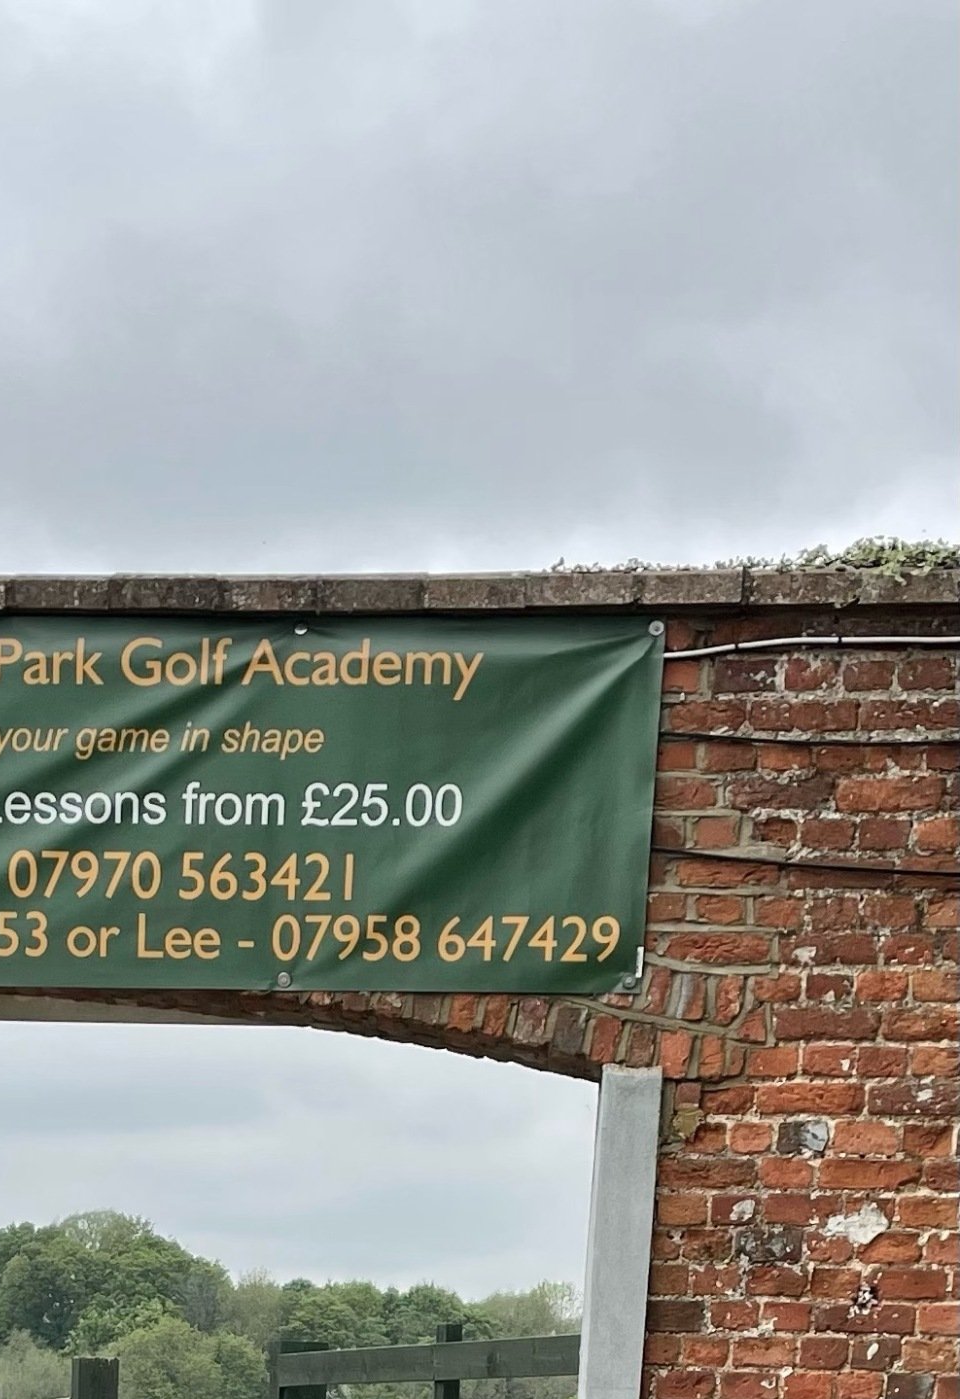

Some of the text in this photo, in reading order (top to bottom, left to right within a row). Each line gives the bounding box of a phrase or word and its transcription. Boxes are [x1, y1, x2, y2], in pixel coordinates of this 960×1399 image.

[120, 638, 232, 686] Golf
[242, 638, 484, 700] Academy
[75, 728, 170, 760] game
[180, 722, 210, 753] in
[221, 721, 325, 760] shape
[182, 781, 284, 826] from
[301, 783, 463, 827] £25.00
[7, 850, 162, 899] 07970
[178, 852, 355, 901] 563421
[66, 924, 119, 958] or
[136, 913, 221, 959] Lee
[271, 914, 421, 962] 07958
[438, 916, 621, 963] 647429
